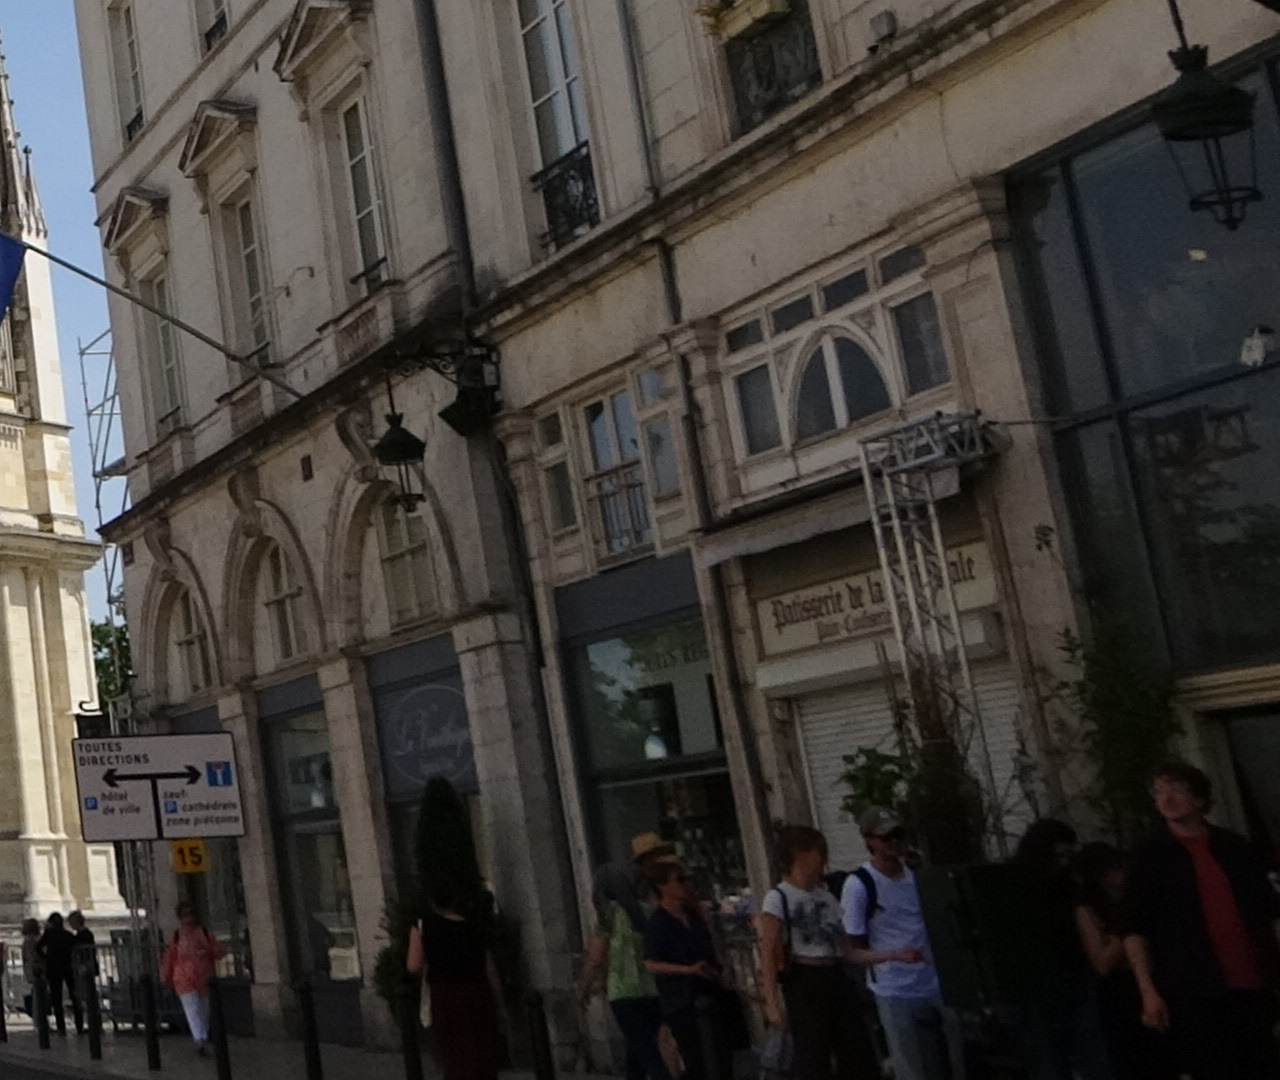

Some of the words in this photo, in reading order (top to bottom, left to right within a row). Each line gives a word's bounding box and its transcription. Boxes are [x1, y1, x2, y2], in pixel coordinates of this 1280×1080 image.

[845, 582, 865, 610] de
[865, 575, 885, 604] la
[78, 742, 122, 753] TOUTES
[79, 754, 150, 767] DIRECTIONS
[102, 806, 116, 816] de
[119, 804, 141, 815] ville
[177, 846, 203, 867] 15
